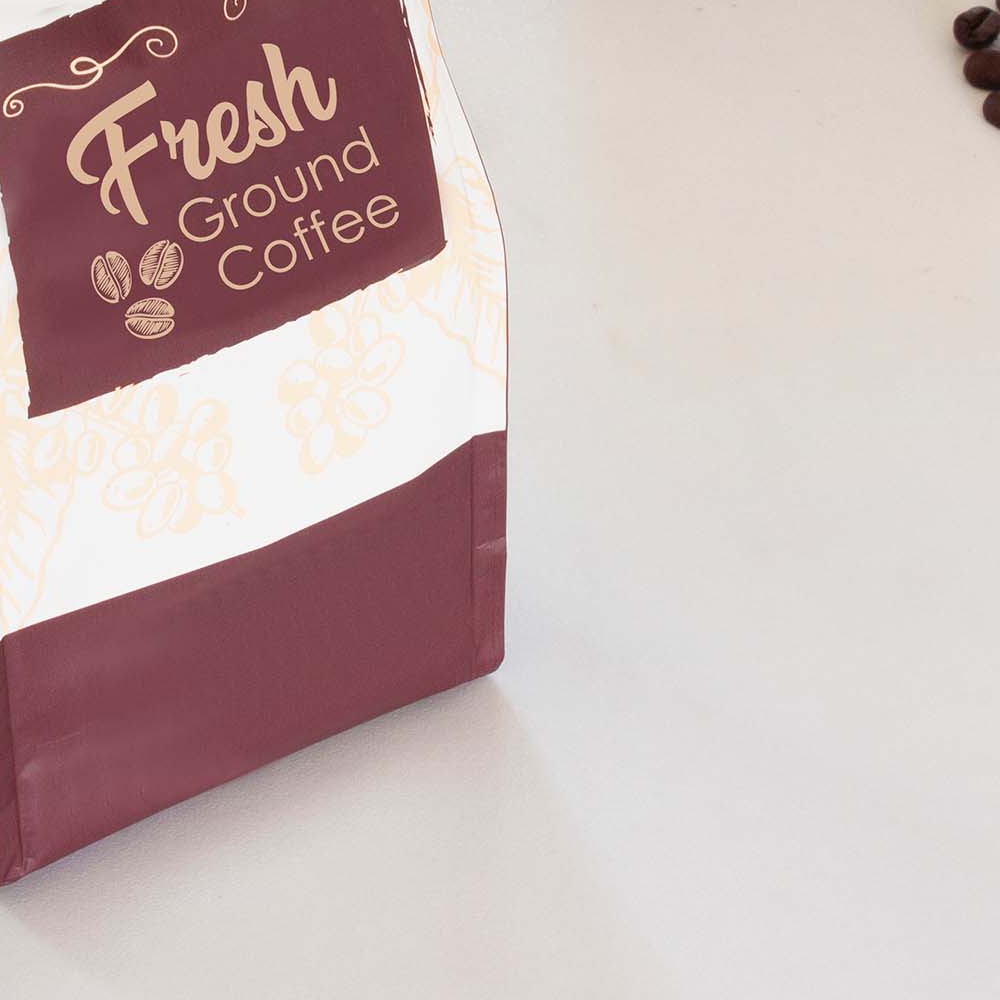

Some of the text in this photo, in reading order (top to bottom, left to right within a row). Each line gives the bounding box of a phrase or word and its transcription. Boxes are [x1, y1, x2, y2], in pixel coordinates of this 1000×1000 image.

[66, 43, 336, 226] Fresh
[178, 125, 381, 243] Ground
[218, 194, 400, 291] Coffee
